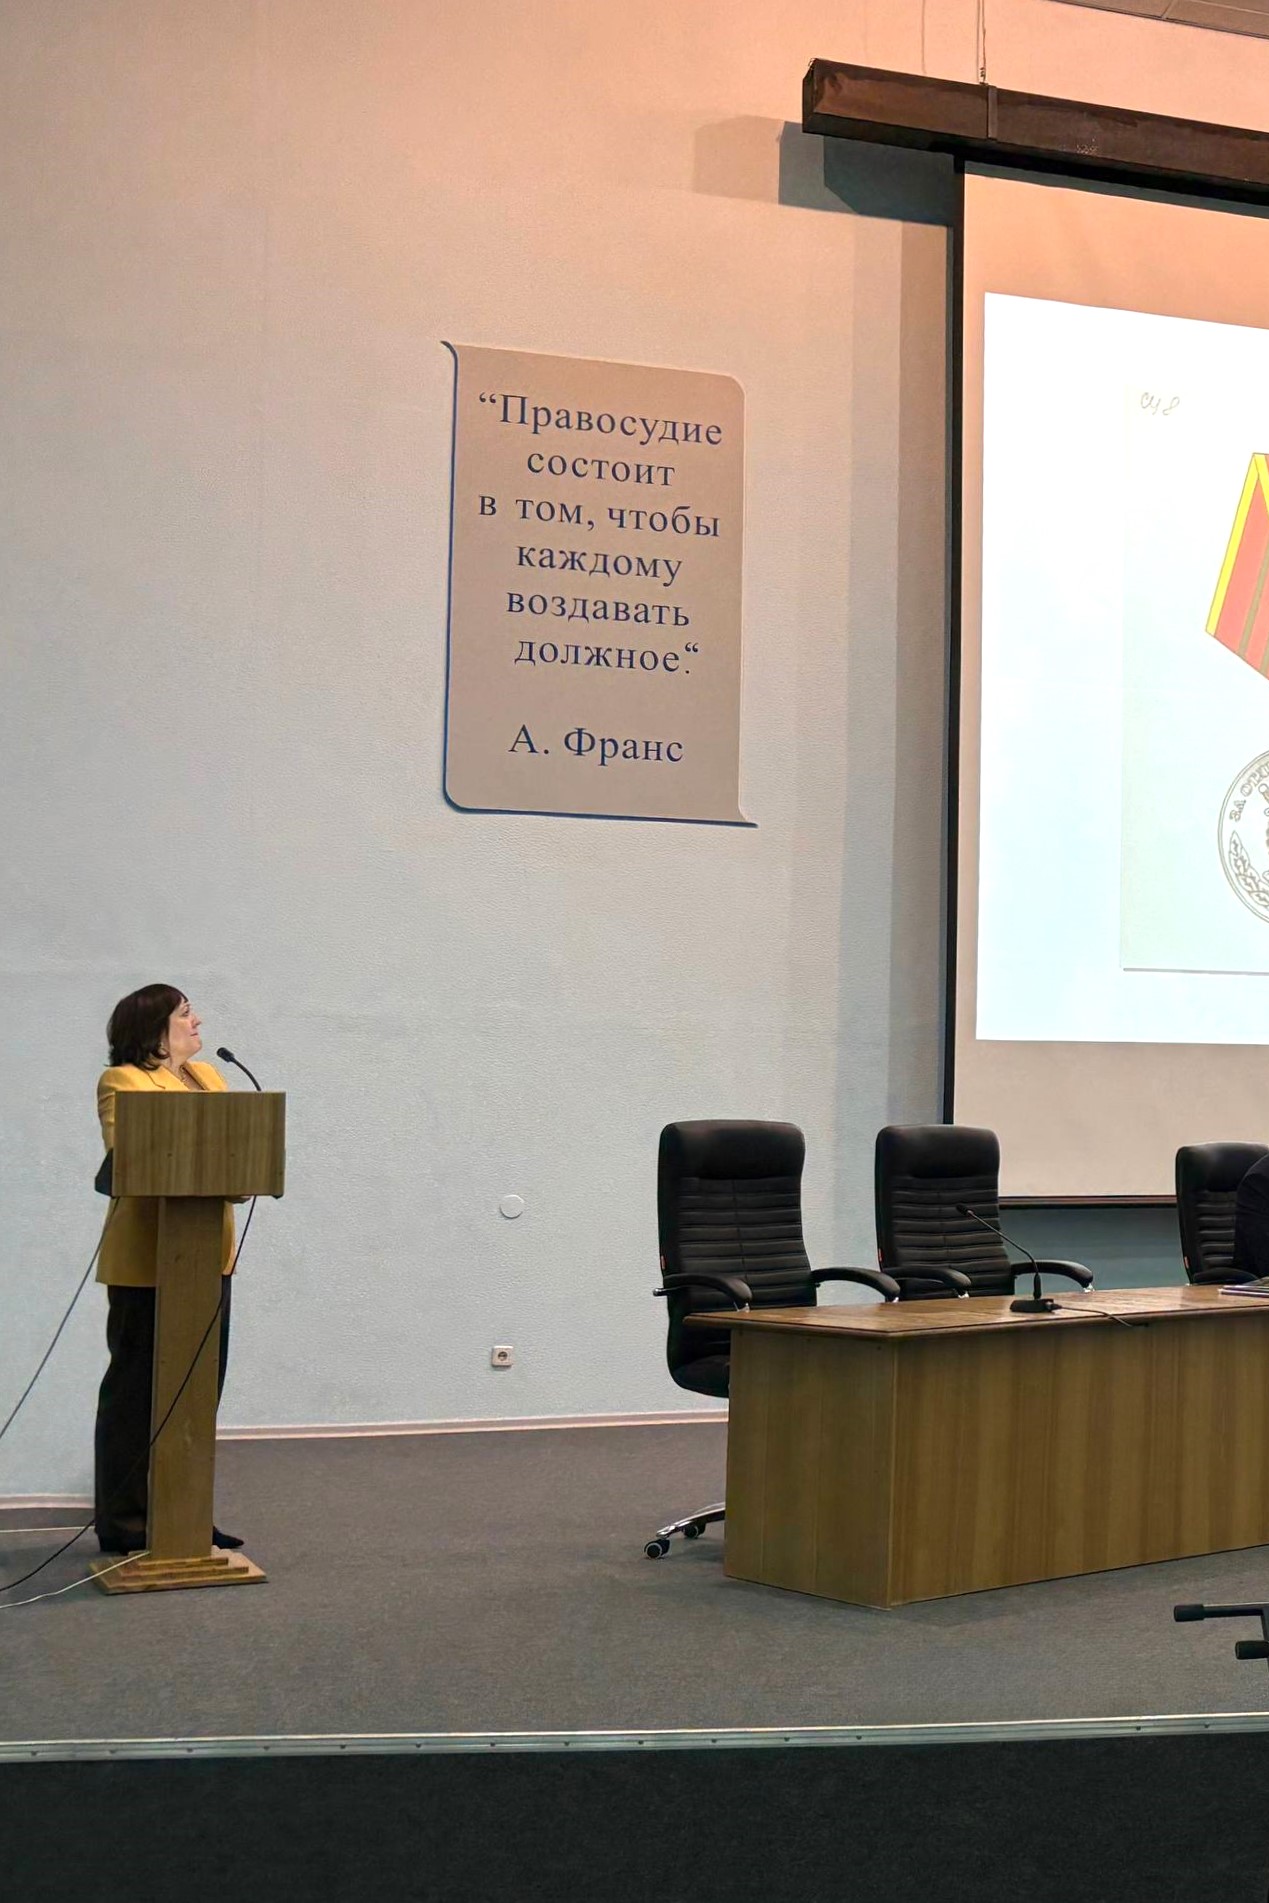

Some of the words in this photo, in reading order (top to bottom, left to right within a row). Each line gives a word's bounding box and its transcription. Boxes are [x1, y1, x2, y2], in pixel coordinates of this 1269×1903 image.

[527, 452, 675, 487] состоит
[479, 495, 497, 517] в
[516, 498, 595, 531] том,
[607, 506, 720, 538] чтобы
[516, 544, 682, 587] каждому
[507, 592, 690, 627] воздавать
[508, 724, 550, 755] А.
[564, 727, 684, 766] Франс
